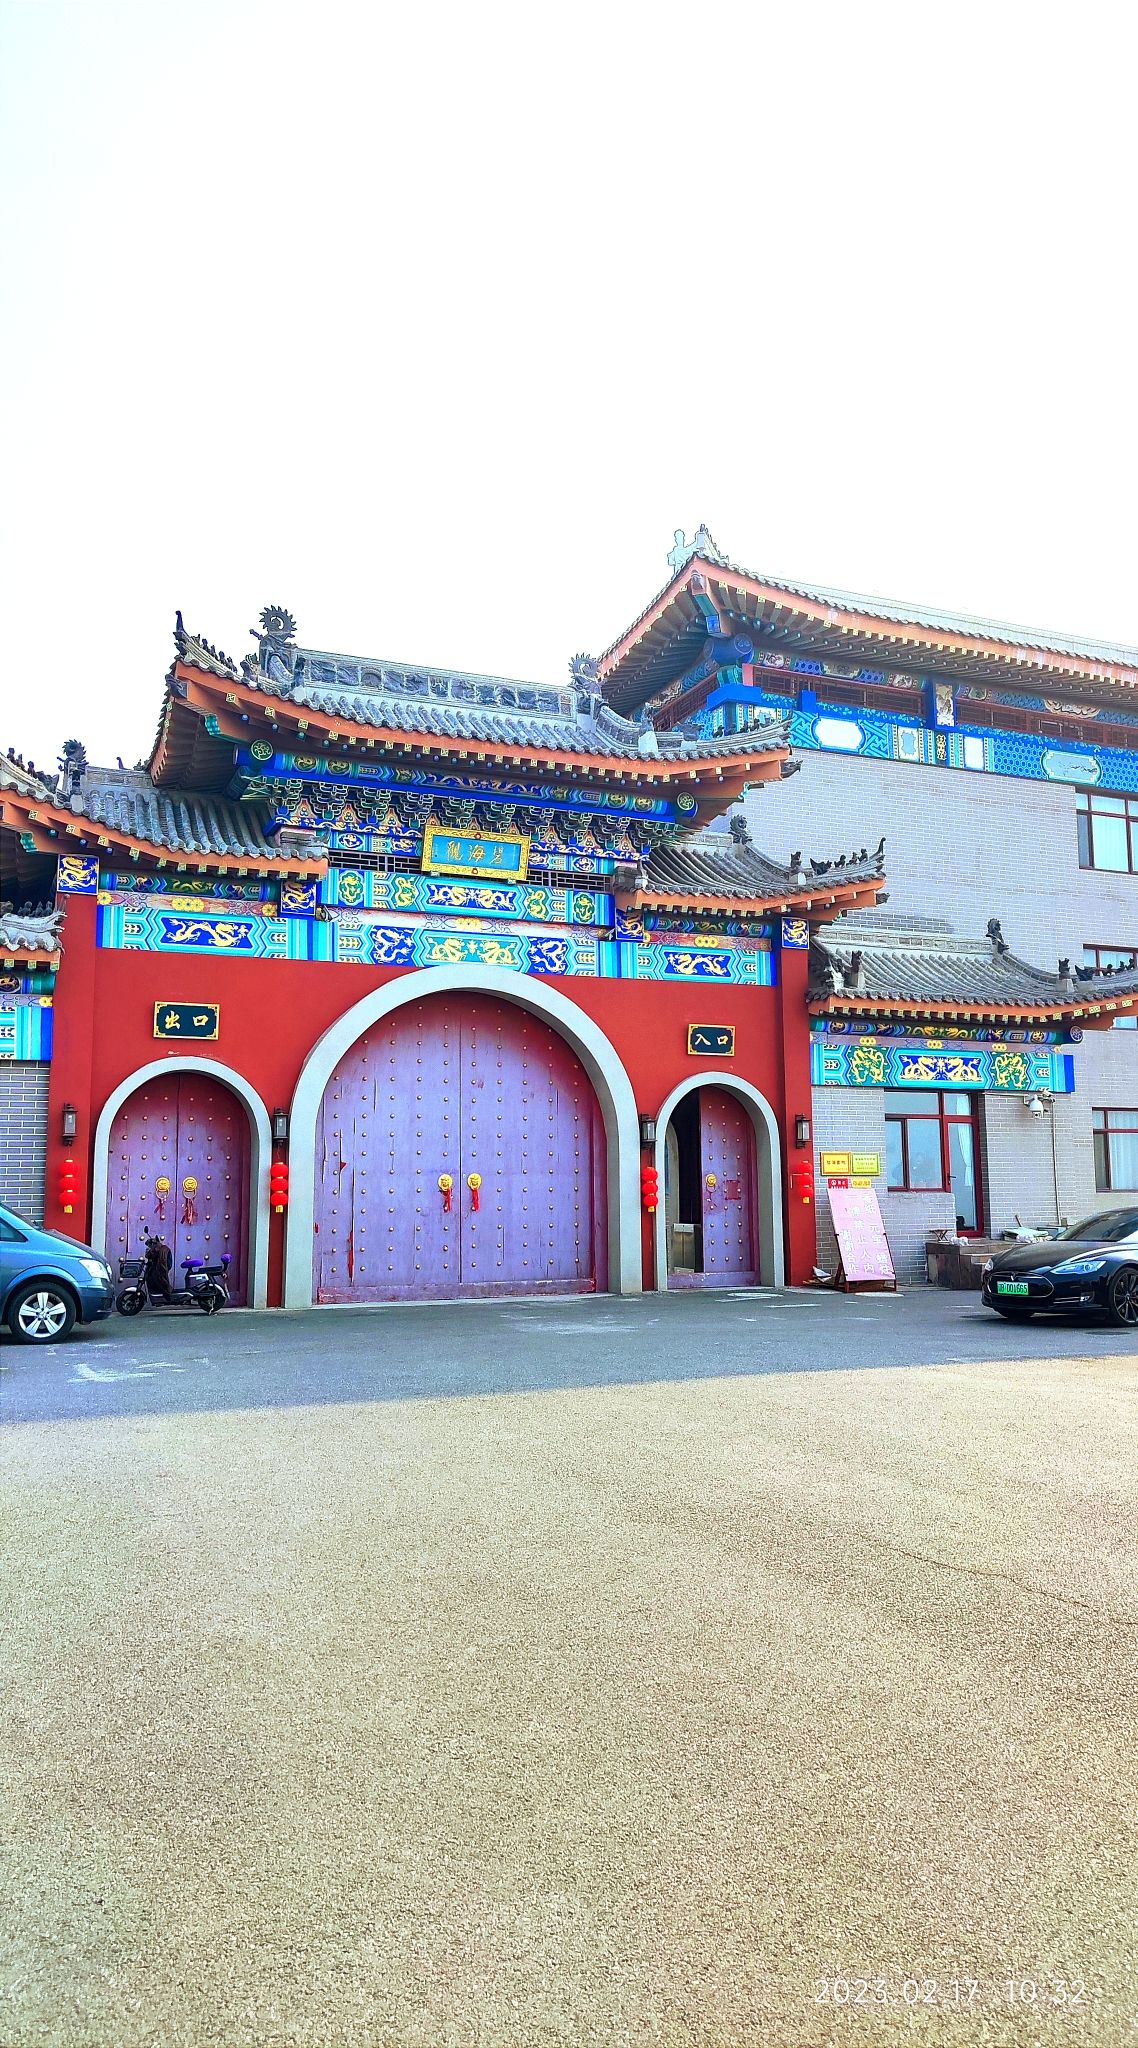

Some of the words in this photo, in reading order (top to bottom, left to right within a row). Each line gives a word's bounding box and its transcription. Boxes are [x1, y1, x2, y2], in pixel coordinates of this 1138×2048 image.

[164, 1010, 209, 1030] 出口
[694, 1033, 729, 1046] 入口
[839, 1230, 859, 1274] 谢谢合作
